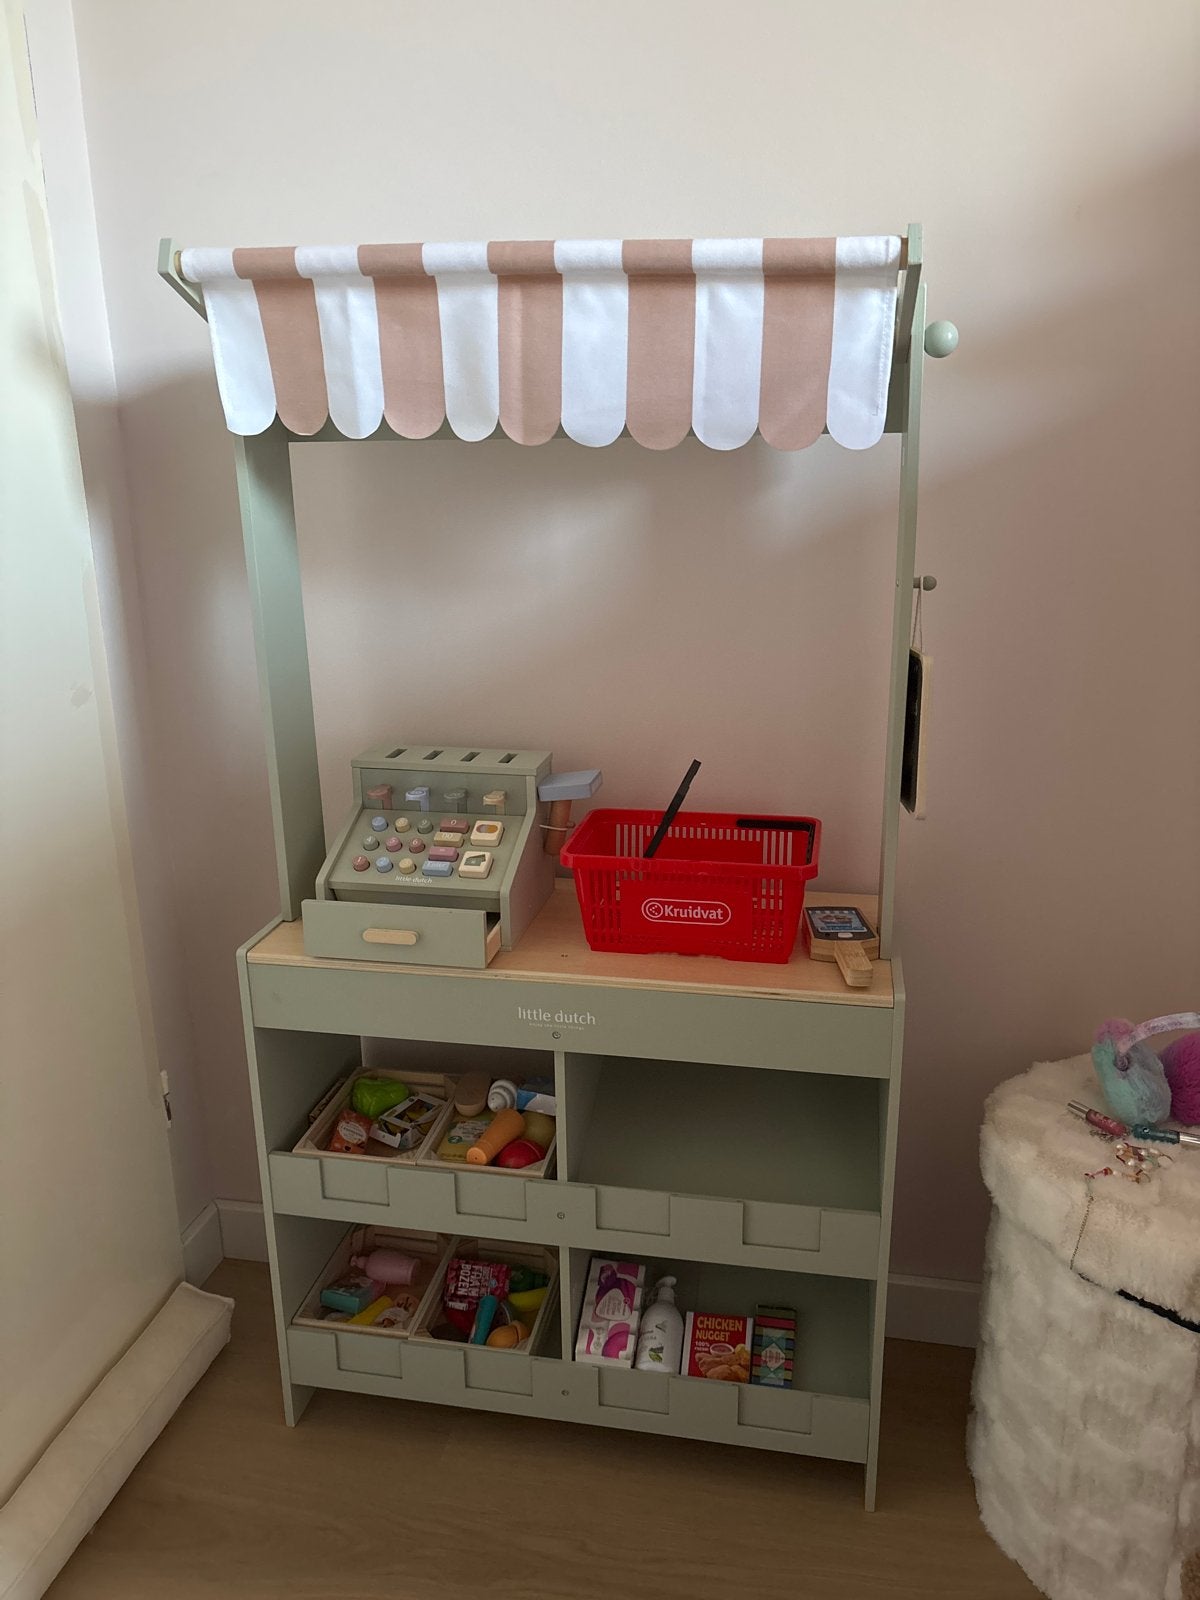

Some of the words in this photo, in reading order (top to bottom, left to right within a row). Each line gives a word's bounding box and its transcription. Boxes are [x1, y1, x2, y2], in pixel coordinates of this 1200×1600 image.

[664, 905, 724, 920] Kruidvat
[518, 1006, 551, 1022] little
[554, 1010, 596, 1025] dutch
[456, 1263, 472, 1296] BOZEN
[696, 1316, 743, 1332] CHICKEN
[695, 1329, 731, 1342] NUGGET
